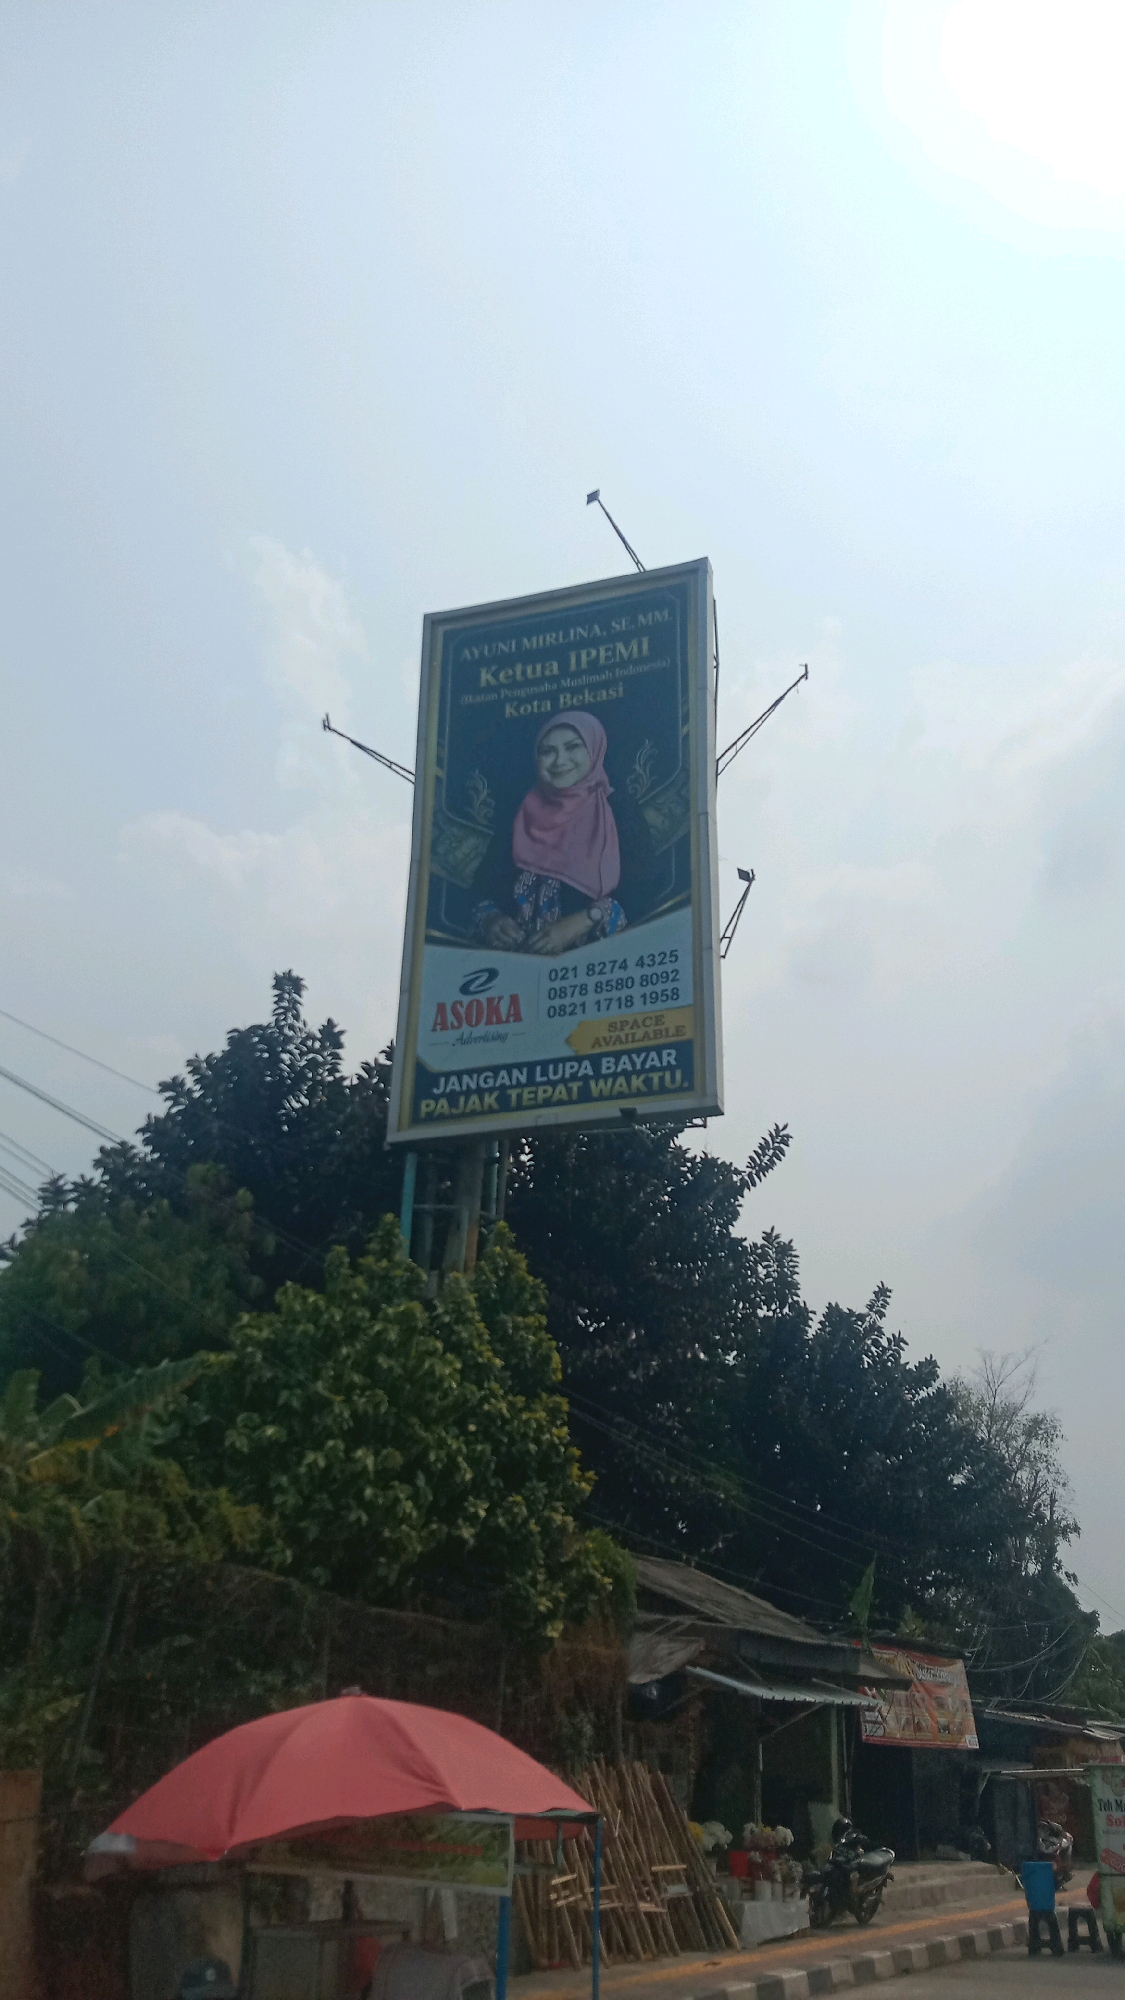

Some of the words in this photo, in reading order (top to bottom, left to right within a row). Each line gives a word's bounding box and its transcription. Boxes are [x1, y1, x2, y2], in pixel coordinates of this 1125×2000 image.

[460, 641, 517, 661] AYUNI
[479, 660, 559, 687] Ketua
[569, 636, 650, 673] IPEMI
[561, 670, 613, 688] Muslimah
[504, 700, 551, 718] Kota
[559, 681, 624, 709] Bekasi
[548, 965, 579, 982] 021
[586, 958, 629, 977] 8274
[635, 949, 679, 968] 4325
[547, 983, 588, 1001] 0878
[594, 976, 635, 996] 8580
[640, 969, 680, 989] 8092
[431, 993, 523, 1032] ASOKA
[547, 1001, 587, 1018] 0821
[596, 994, 634, 1013] 1718
[642, 987, 680, 1007] 1958
[452, 1030, 509, 1046] Advertising
[591, 1024, 687, 1049] AVAILABLE
[608, 1014, 665, 1033] SPACE
[433, 1067, 528, 1095] JANGAN
[535, 1060, 594, 1082] LUPA
[601, 1049, 677, 1074] BAYAR
[420, 1090, 500, 1118] PAJAK
[507, 1081, 583, 1108] TEPAT
[590, 1069, 689, 1097] WAKTU.
